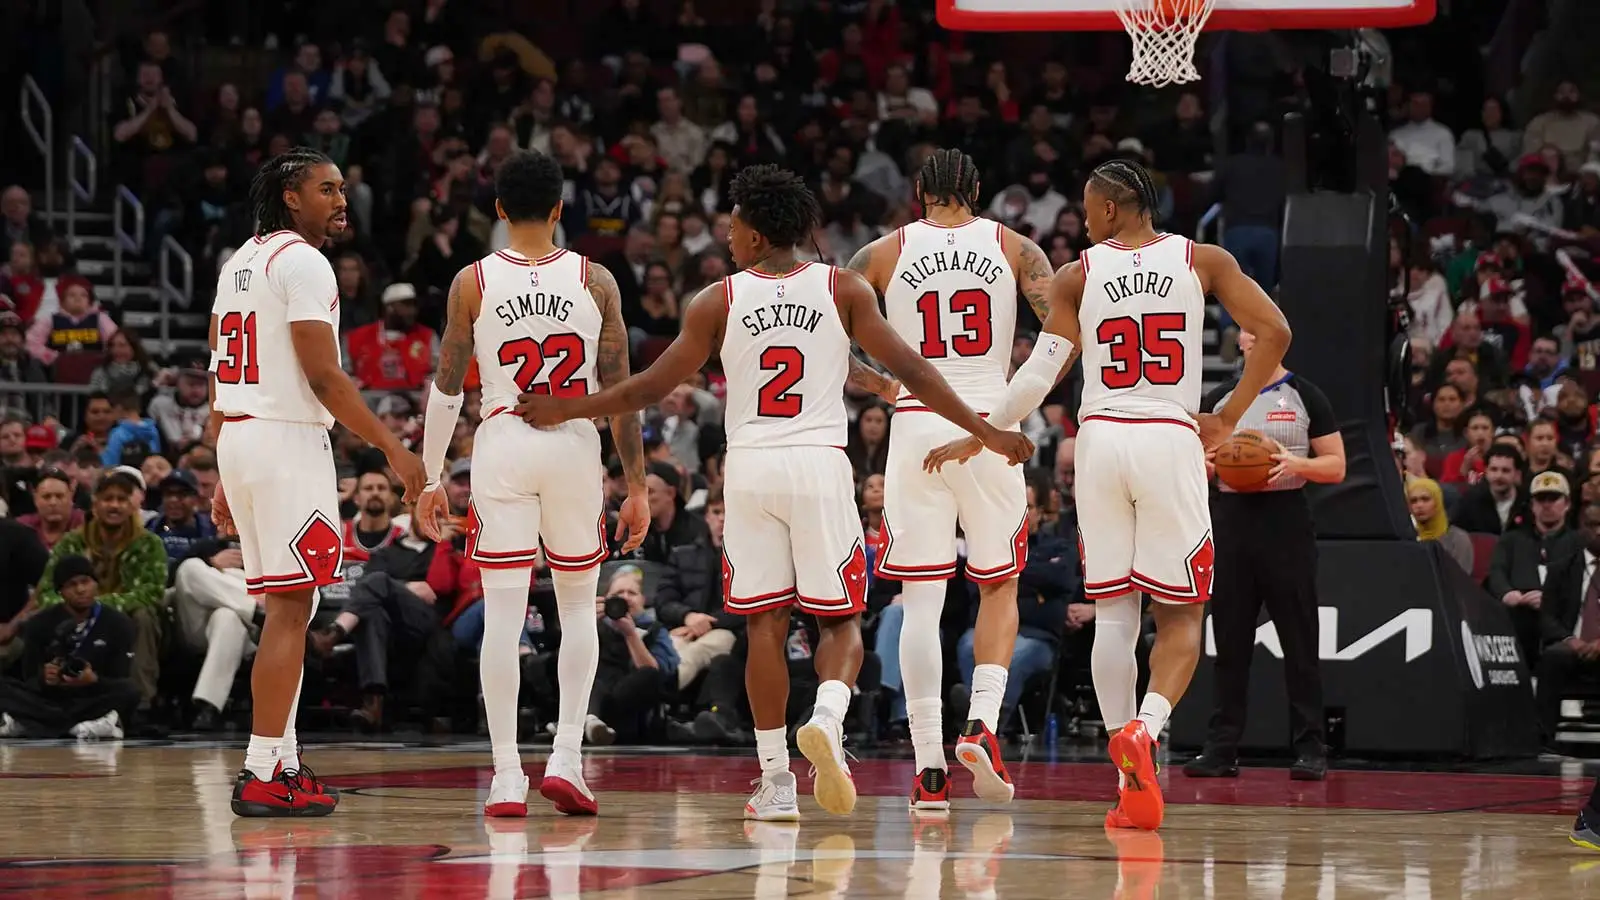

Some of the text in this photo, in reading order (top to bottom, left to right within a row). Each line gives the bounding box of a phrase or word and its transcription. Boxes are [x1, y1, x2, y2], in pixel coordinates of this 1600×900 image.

[900, 250, 1003, 290] RICHARDS
[1103, 271, 1174, 303] OKORO
[495, 292, 574, 327] SIMONS
[742, 303, 824, 337] SEXTON
[916, 288, 993, 359] 13
[215, 311, 260, 385] 31
[497, 332, 589, 398] 22
[1096, 312, 1187, 390] 35
[757, 346, 805, 419] 2
